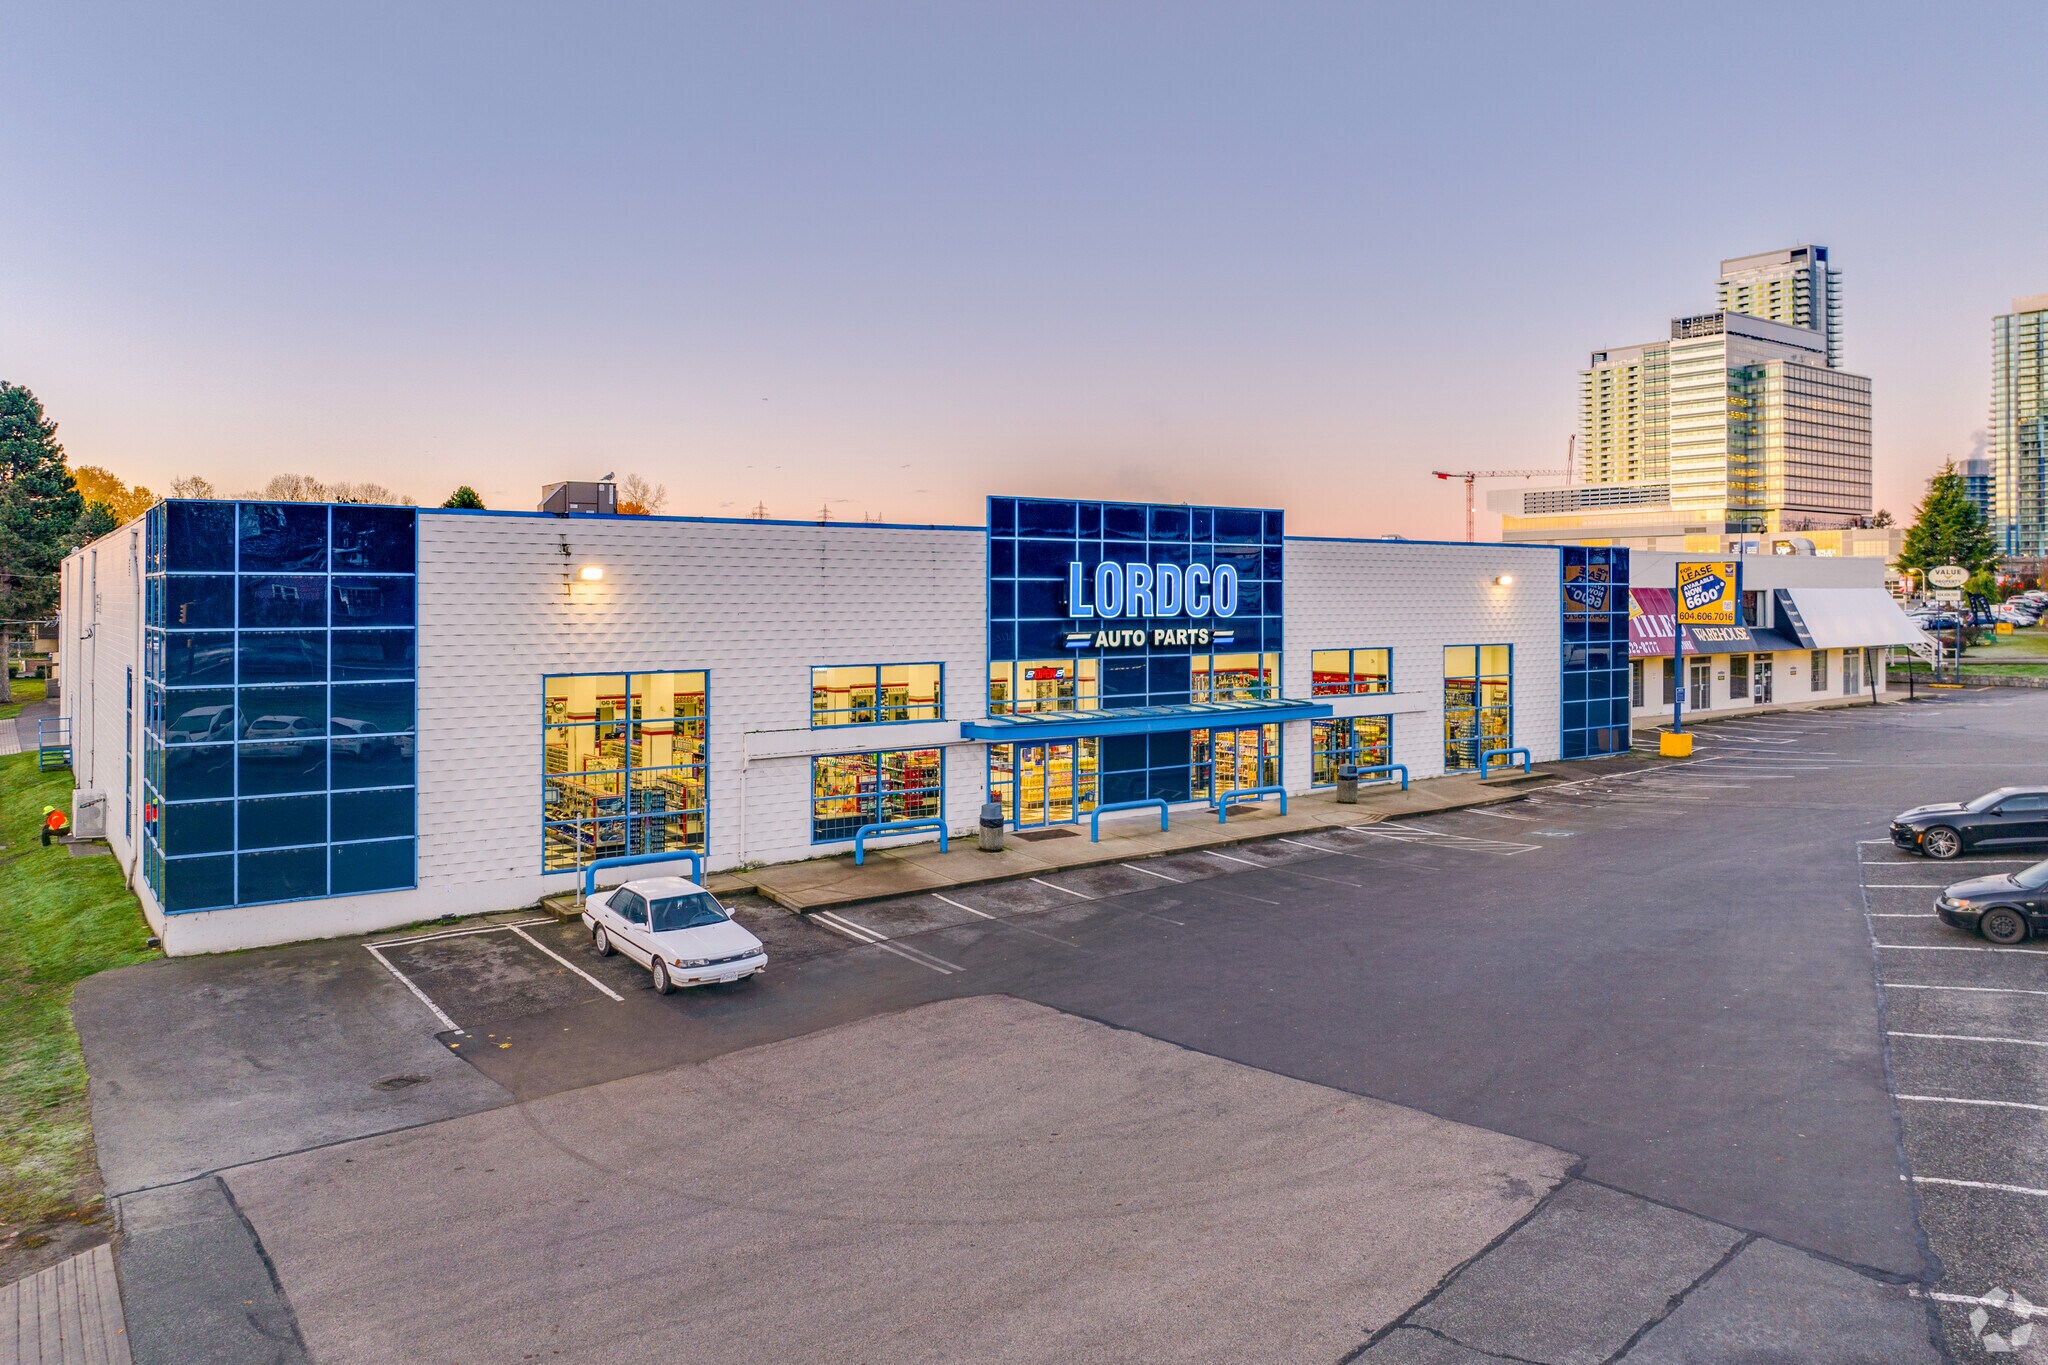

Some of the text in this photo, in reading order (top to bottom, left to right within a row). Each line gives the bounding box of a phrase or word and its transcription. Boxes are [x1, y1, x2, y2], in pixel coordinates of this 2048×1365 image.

[1679, 566, 1692, 574] FOR
[1681, 564, 1713, 582] LEASE
[1069, 561, 1238, 618] LORDCO
[1683, 575, 1715, 591] AVAILABLE
[1685, 585, 1703, 598] NOW
[1686, 588, 1718, 609] 6600
[1679, 612, 1734, 622] 604.606.7016
[1094, 628, 1209, 648] AUTO PARTS
[1692, 627, 1750, 642] WAREHOUSE
[1034, 668, 1056, 679] OPEN
